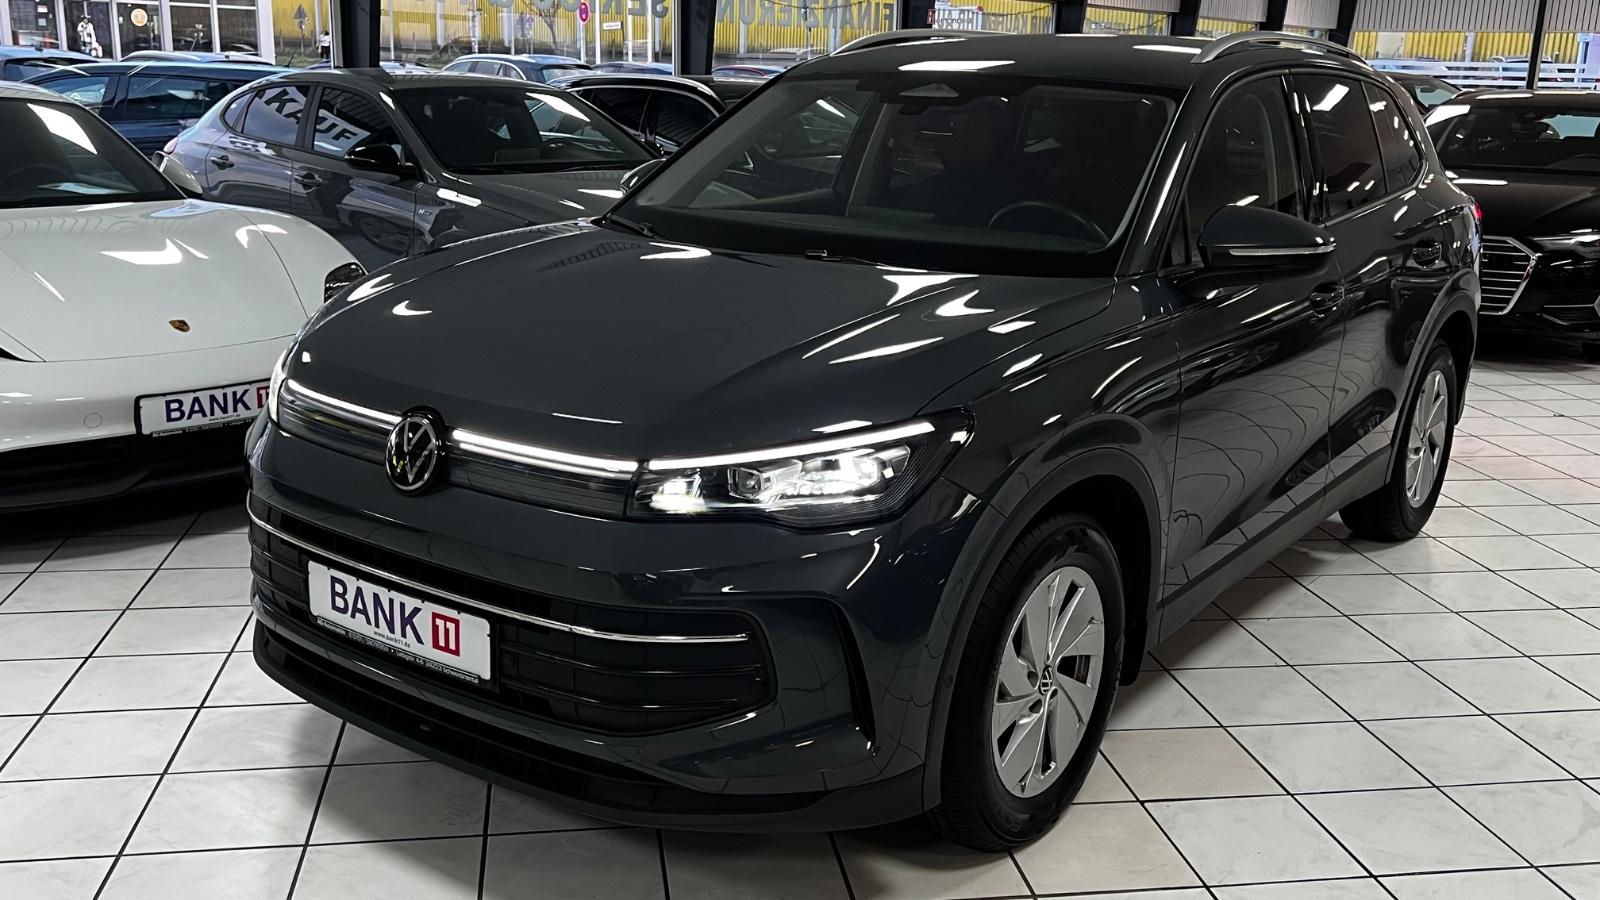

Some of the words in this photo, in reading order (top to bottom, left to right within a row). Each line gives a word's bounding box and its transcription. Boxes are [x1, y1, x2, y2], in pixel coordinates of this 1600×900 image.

[165, 389, 251, 423] BANK
[330, 575, 425, 645] BANK
[434, 616, 458, 652] 11
[373, 630, 411, 648] www.bank11.de
